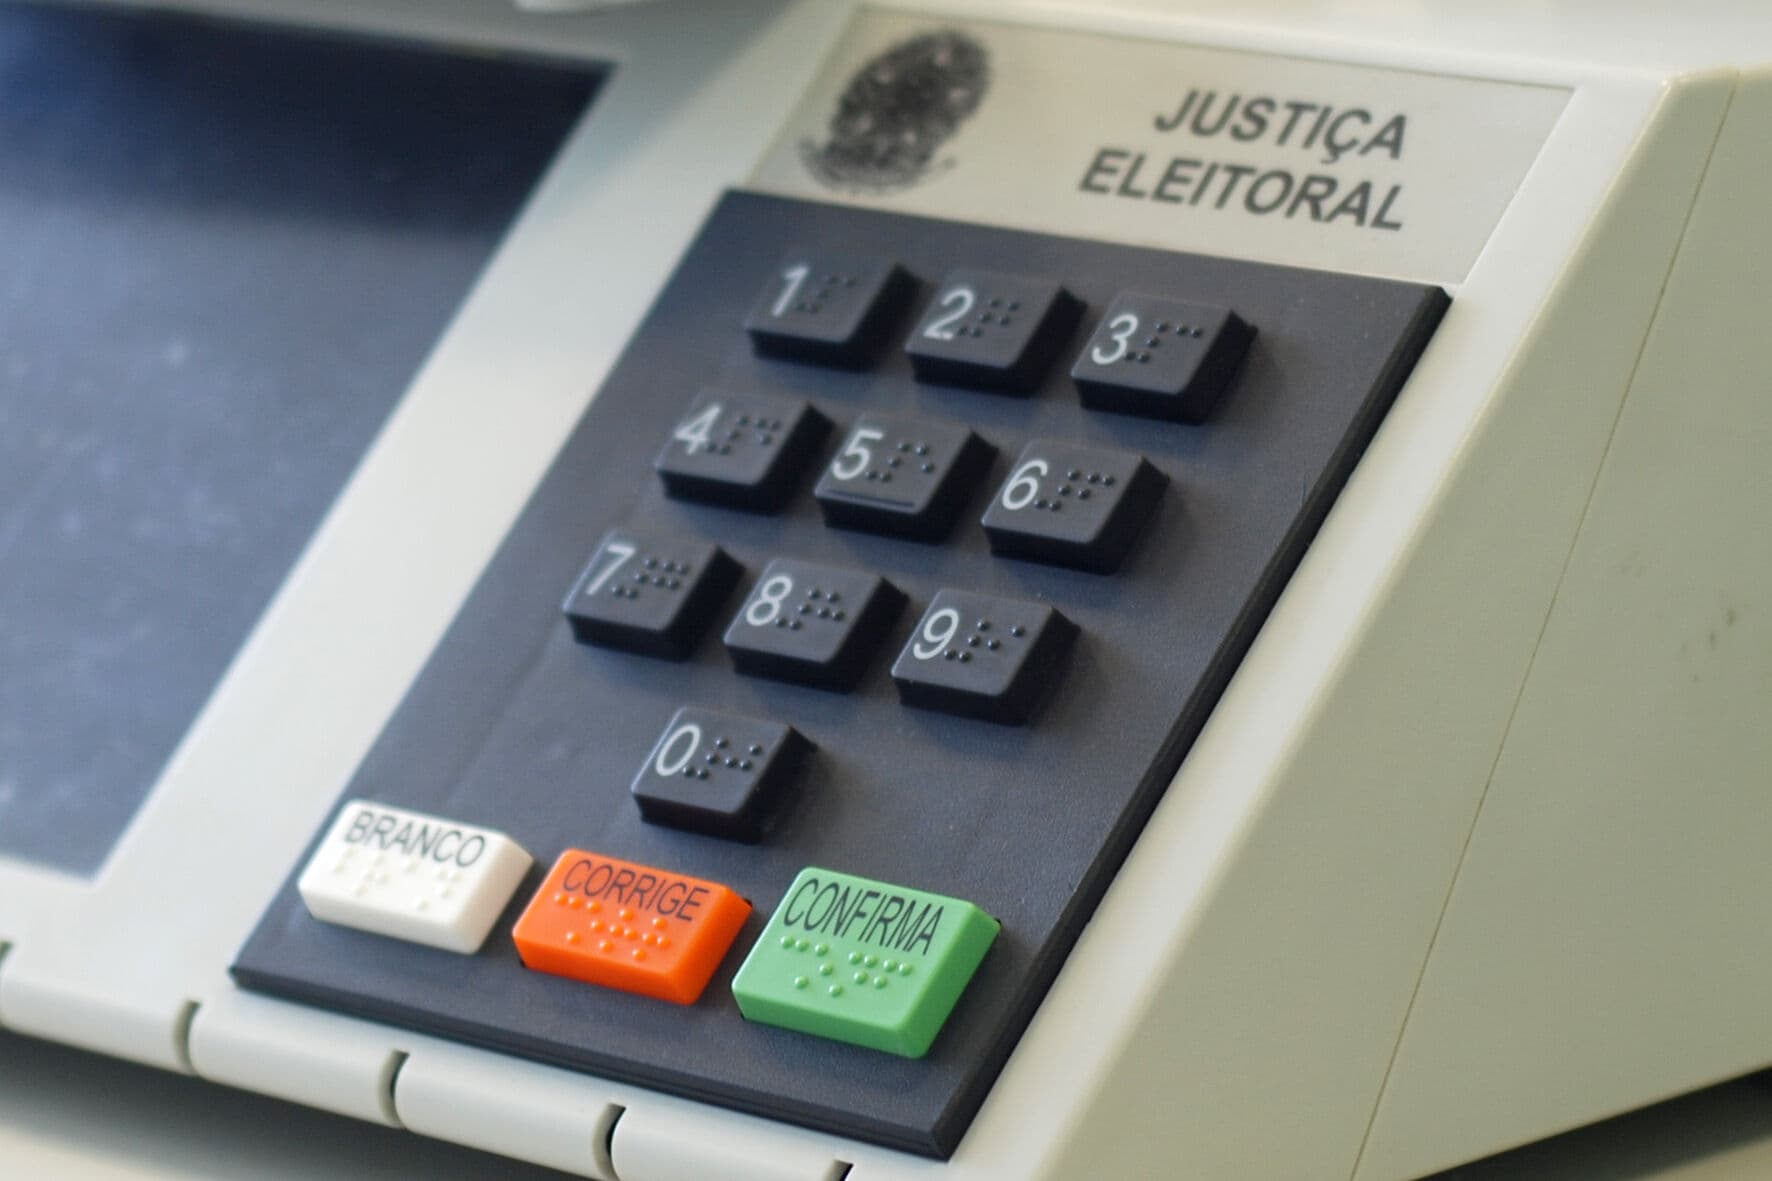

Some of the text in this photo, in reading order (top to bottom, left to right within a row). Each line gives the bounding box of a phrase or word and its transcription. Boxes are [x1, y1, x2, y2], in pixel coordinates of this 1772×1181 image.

[1154, 89, 1407, 164] JUSTIÇA
[1078, 148, 1404, 231] ELEITORAL
[773, 266, 808, 316] 1
[923, 289, 974, 341] 2
[1092, 313, 1139, 365] 3
[675, 405, 720, 455] 4
[832, 430, 883, 480] 5
[1001, 460, 1048, 510] 6
[586, 545, 635, 594] 7
[745, 575, 793, 625] 8
[912, 608, 960, 659] 9
[655, 725, 699, 777] 0
[343, 811, 487, 869] BRANCO
[562, 859, 710, 923] CORRIGE
[783, 877, 944, 956] CONFIRMA
